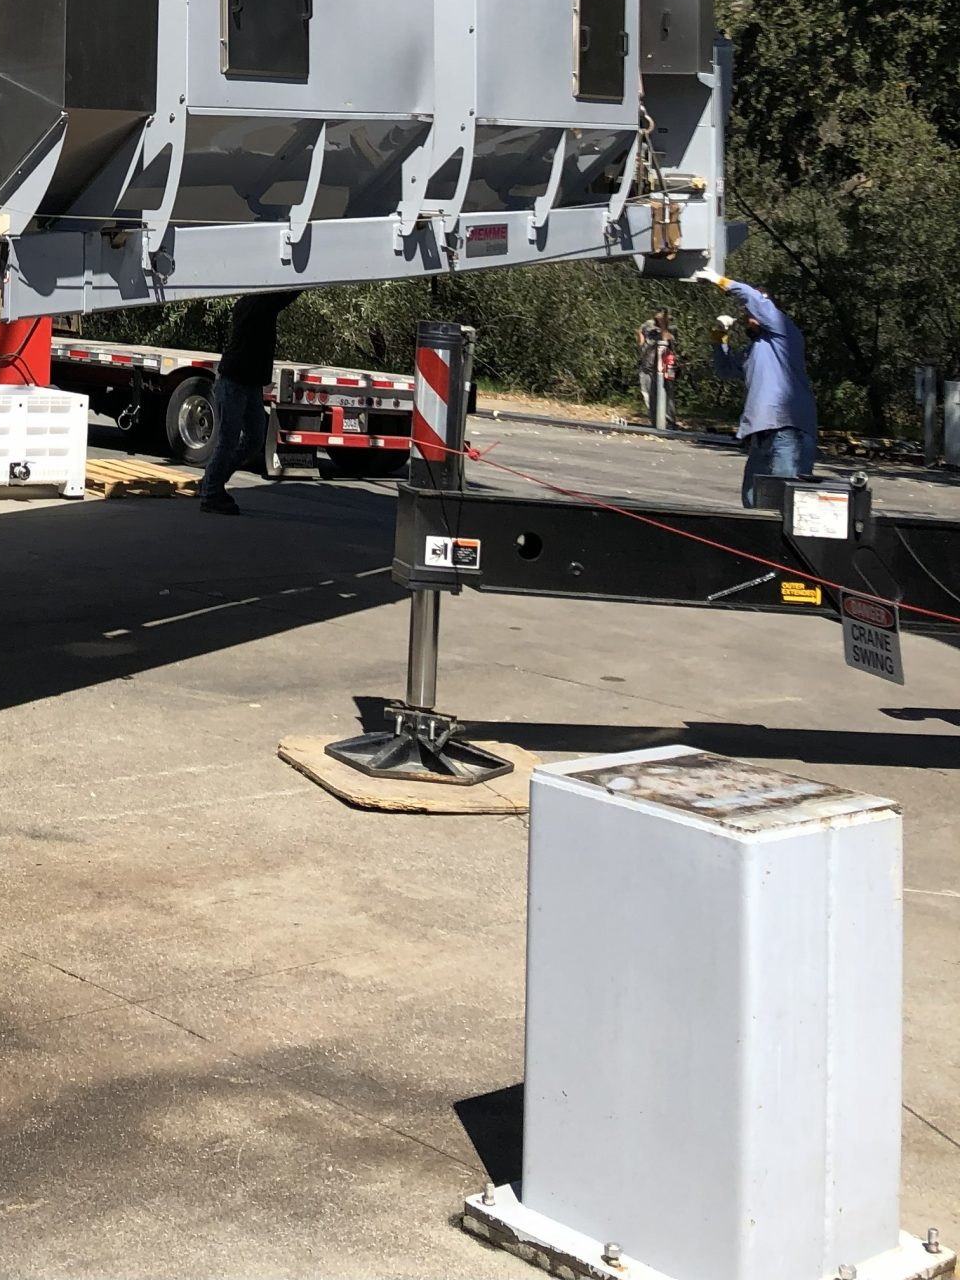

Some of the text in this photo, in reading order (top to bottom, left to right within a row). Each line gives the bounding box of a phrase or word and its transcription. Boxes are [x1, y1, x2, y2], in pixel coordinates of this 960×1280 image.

[781, 582, 805, 590] OUTER
[851, 623, 892, 653] CRANE
[852, 644, 894, 675] SWING
